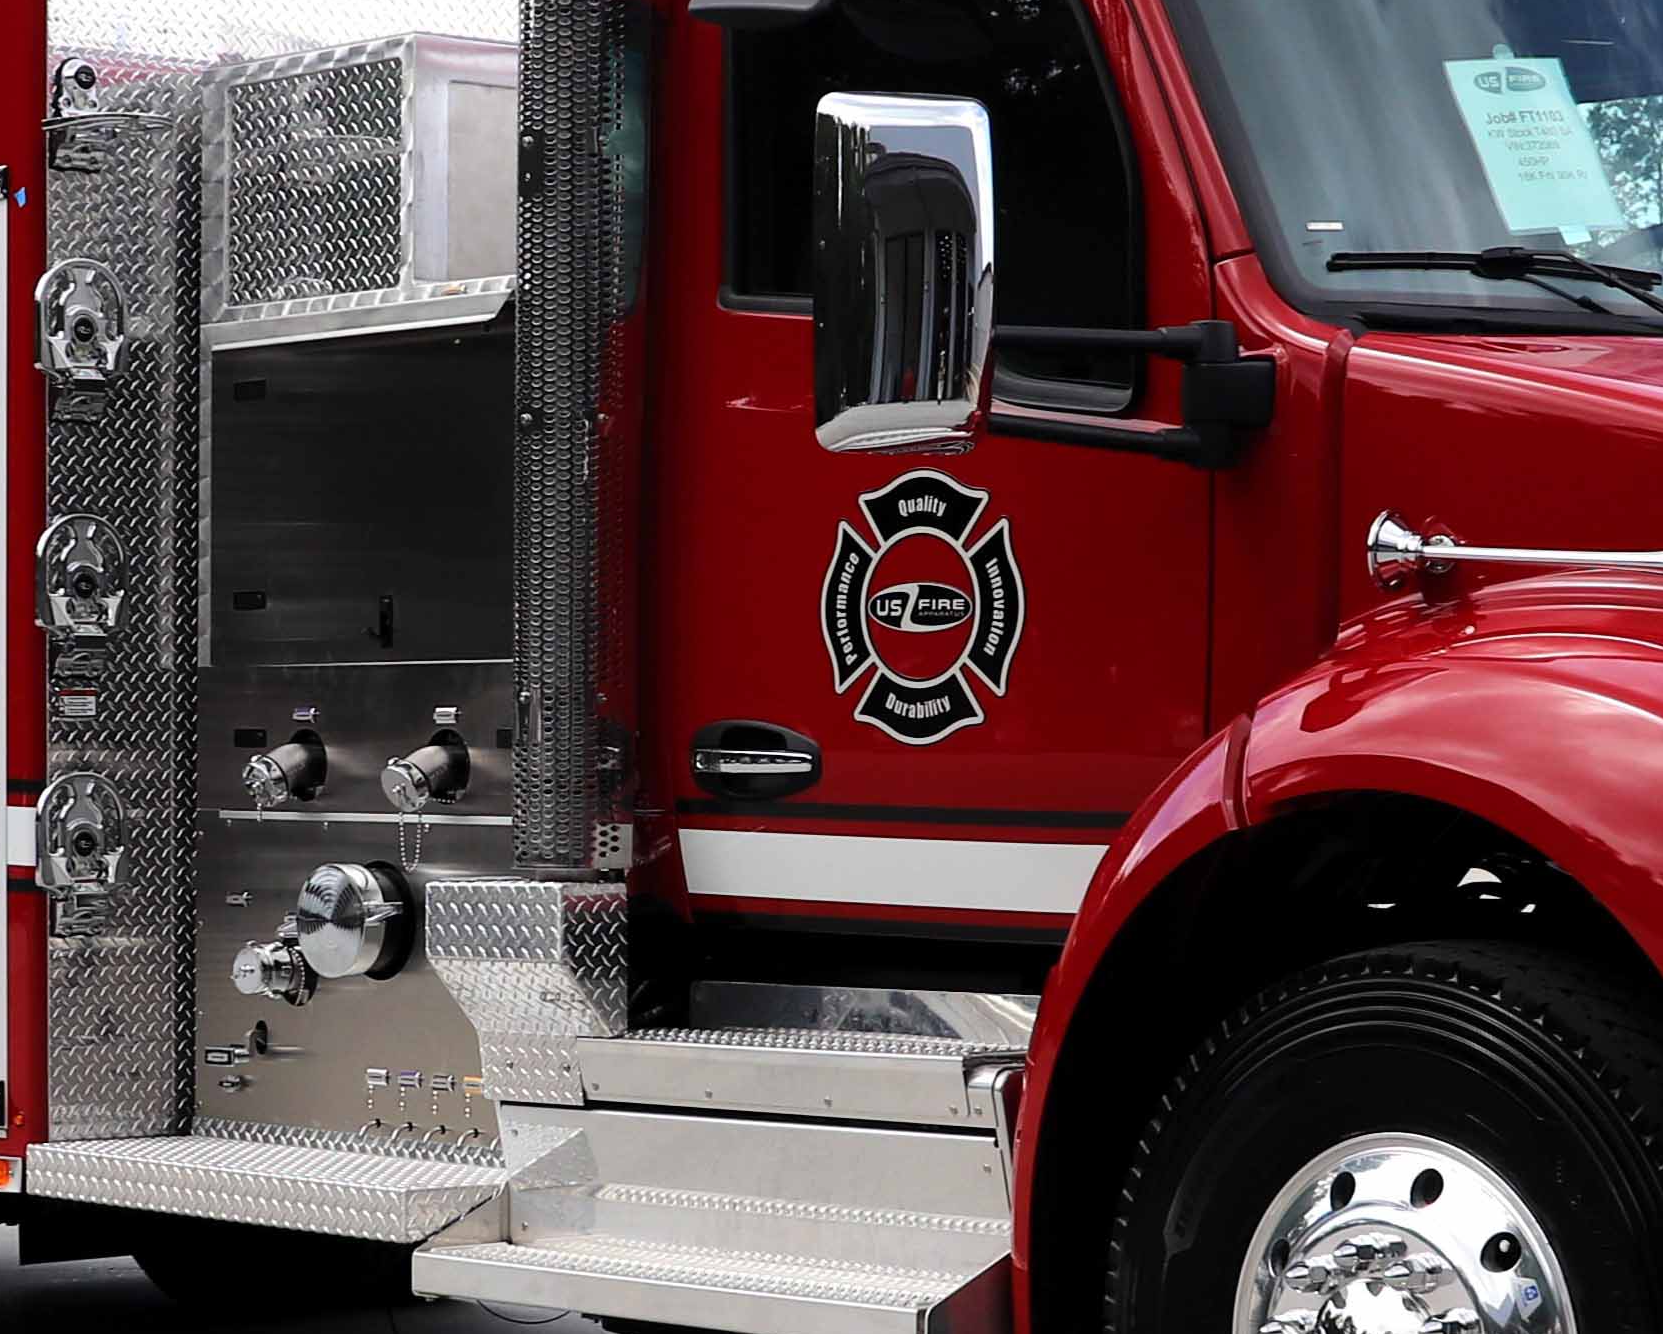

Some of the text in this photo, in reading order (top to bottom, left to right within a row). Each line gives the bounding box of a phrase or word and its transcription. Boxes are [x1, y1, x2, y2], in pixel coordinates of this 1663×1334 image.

[898, 495, 946, 517] Quality
[836, 552, 859, 666] Performance
[876, 599, 965, 617] US FIRE
[984, 557, 1005, 657] Innovation
[885, 692, 951, 719] Durability
